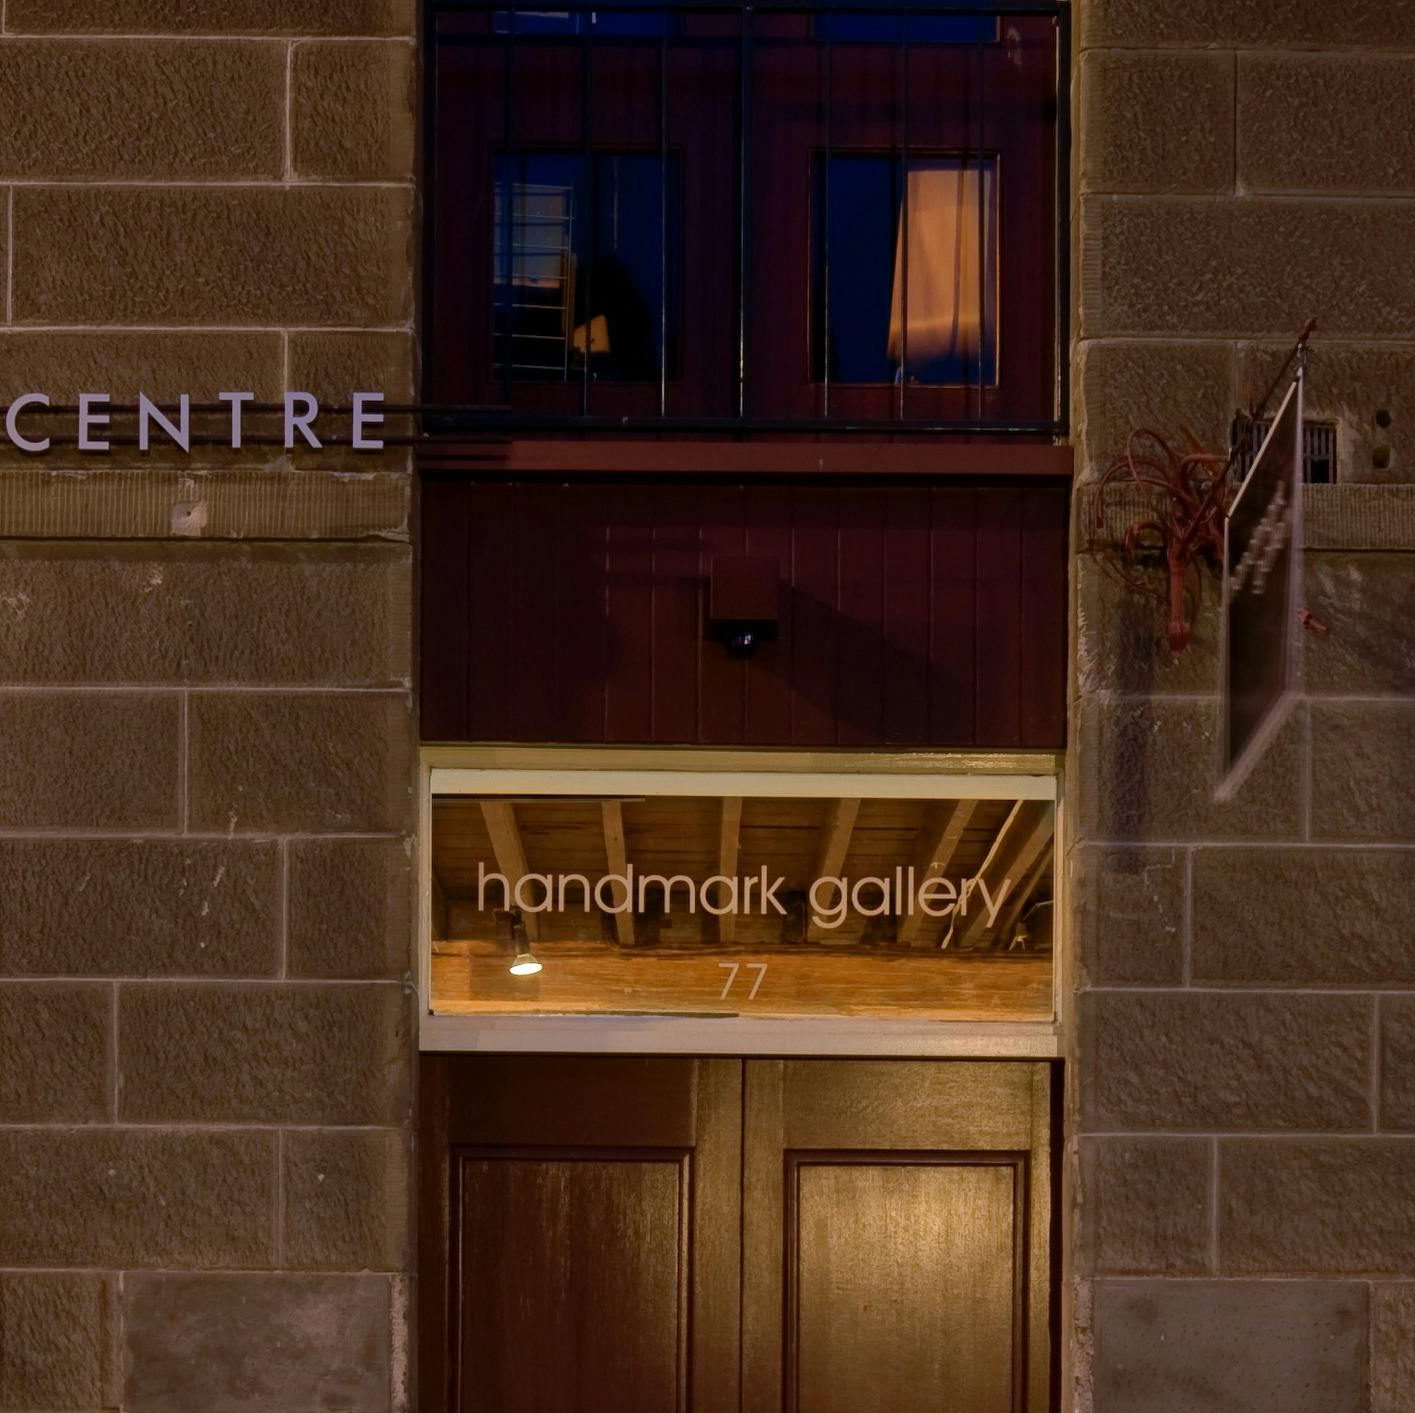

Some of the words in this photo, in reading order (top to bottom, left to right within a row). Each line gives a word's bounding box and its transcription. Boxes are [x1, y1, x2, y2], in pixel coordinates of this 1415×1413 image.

[5, 391, 386, 454] CENTRE
[476, 861, 788, 916] handmark
[809, 865, 1012, 930] gallery
[717, 962, 769, 1001] 77
